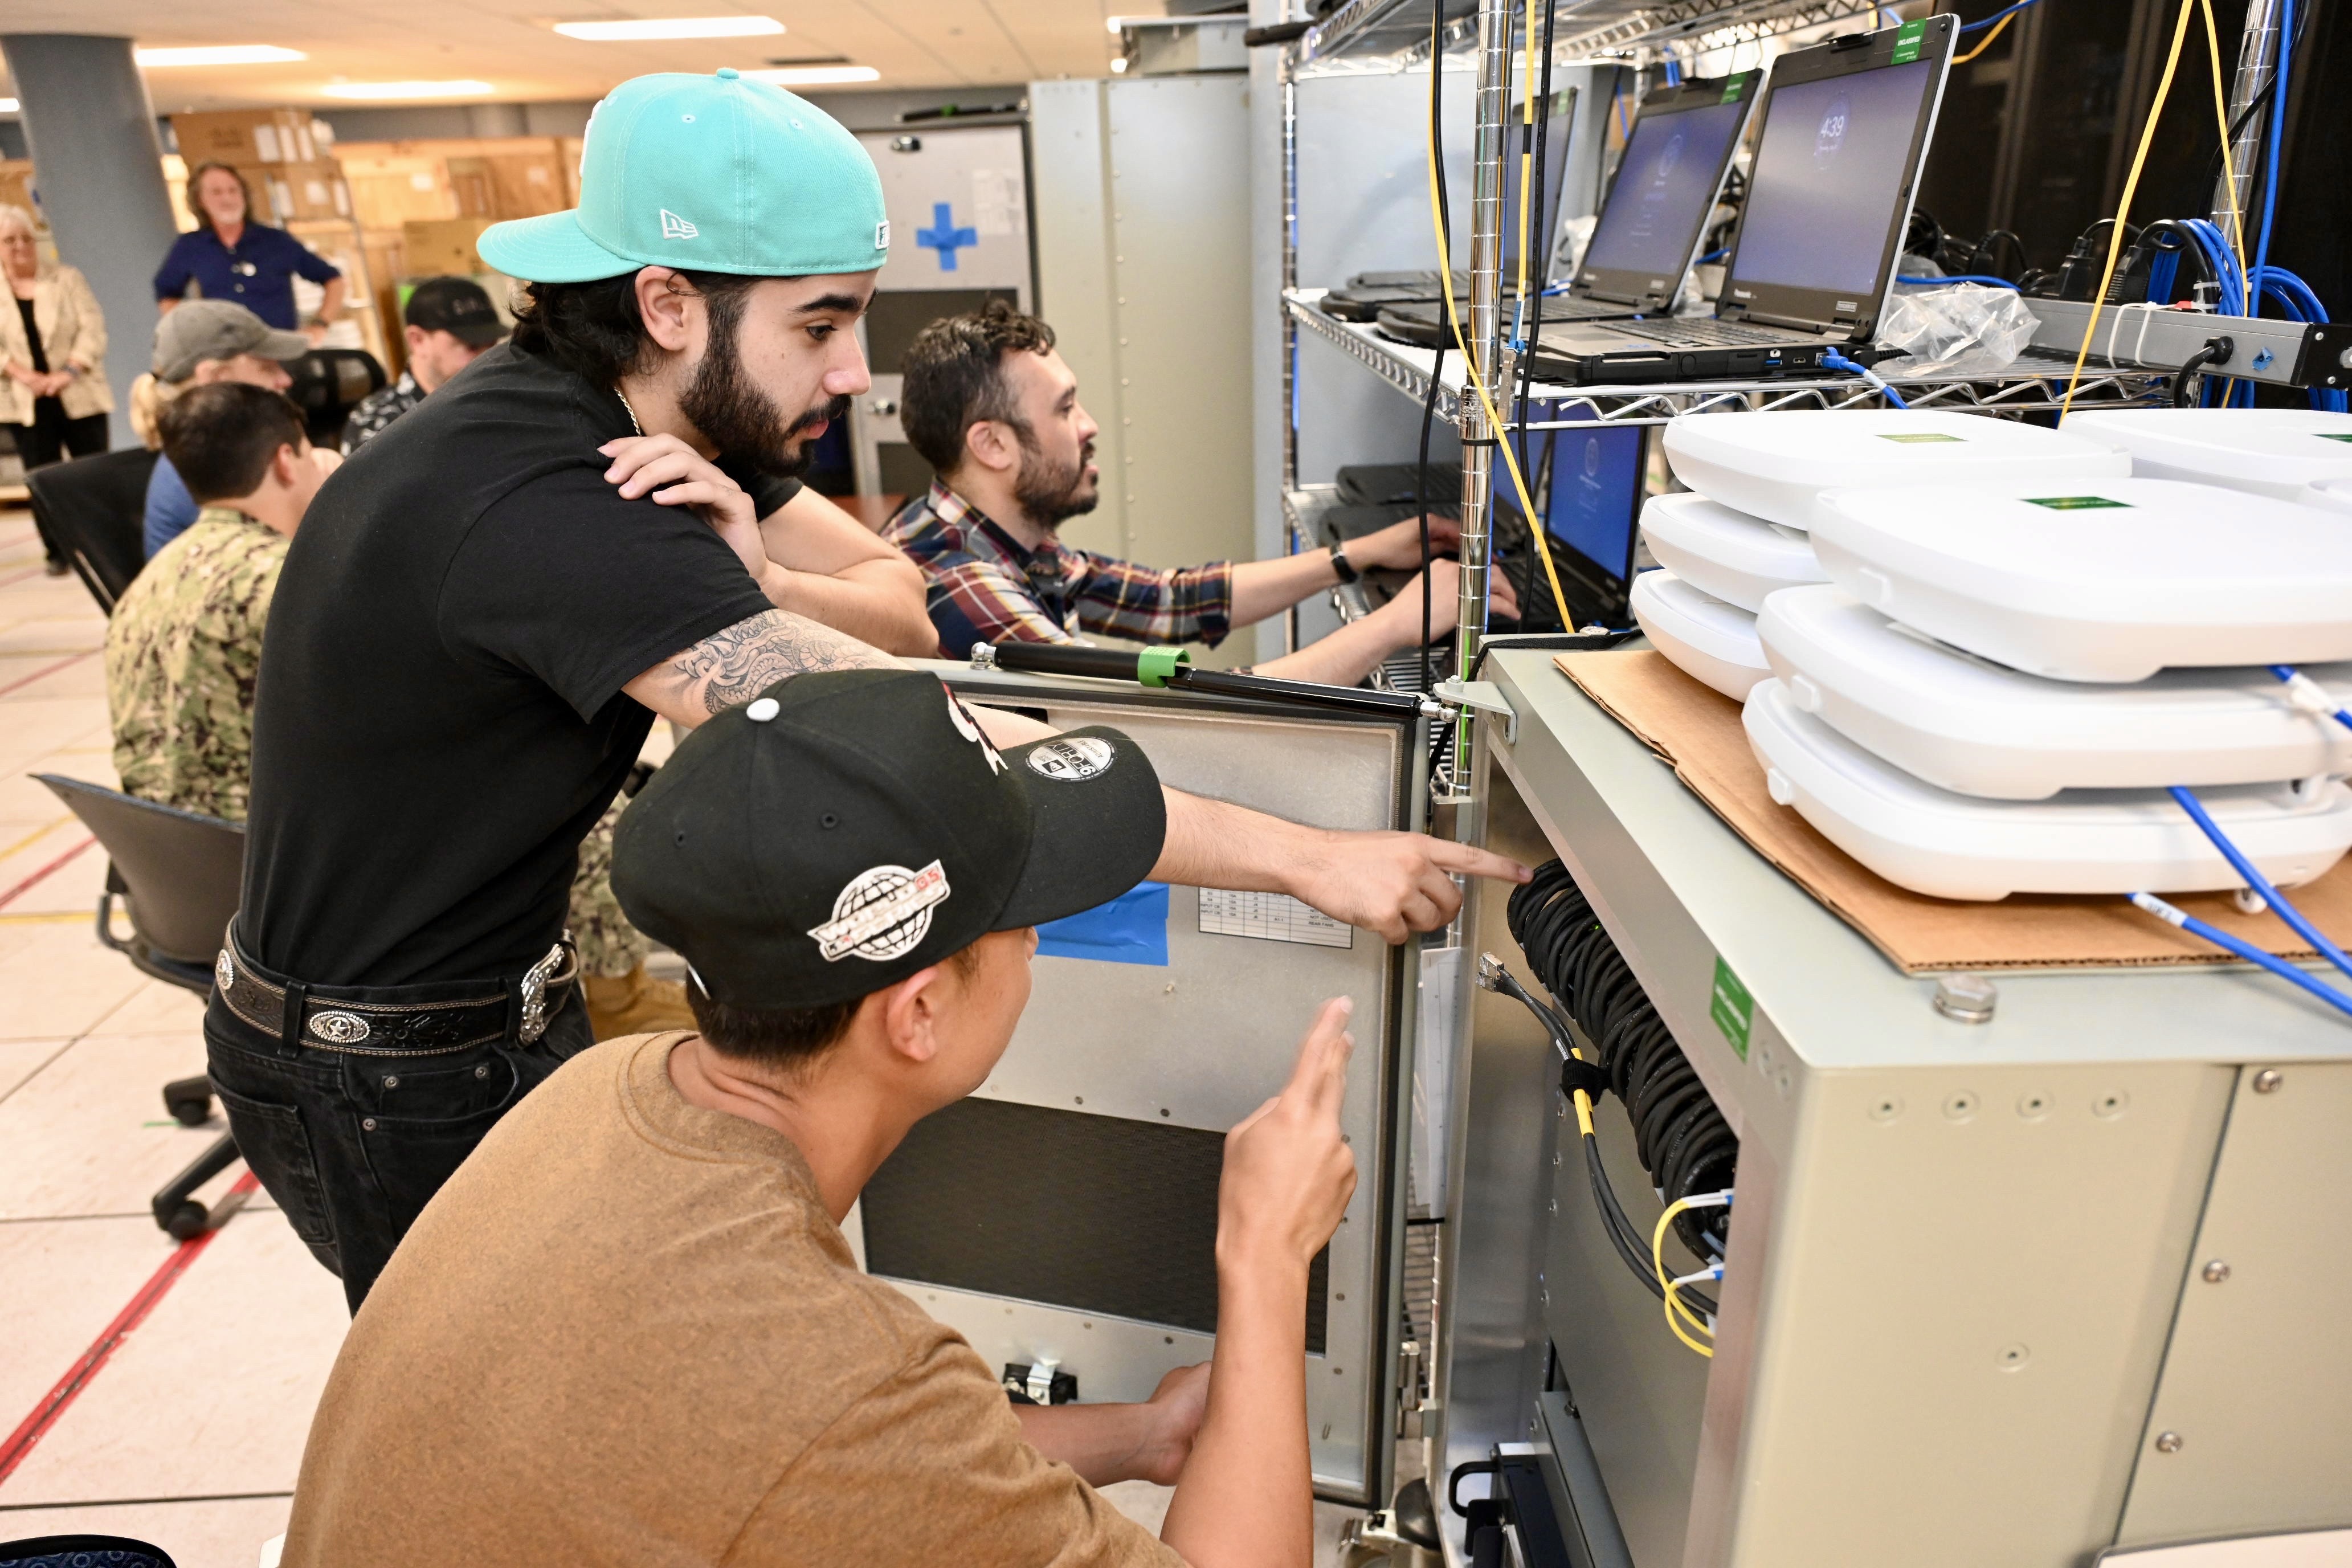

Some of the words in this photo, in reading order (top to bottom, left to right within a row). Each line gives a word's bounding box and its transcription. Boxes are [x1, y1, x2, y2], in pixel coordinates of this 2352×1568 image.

[1820, 115, 1844, 138] 4:39
[1048, 741, 1097, 776] 9FORTY
[1076, 740, 1104, 759] ADJUSTABLE
